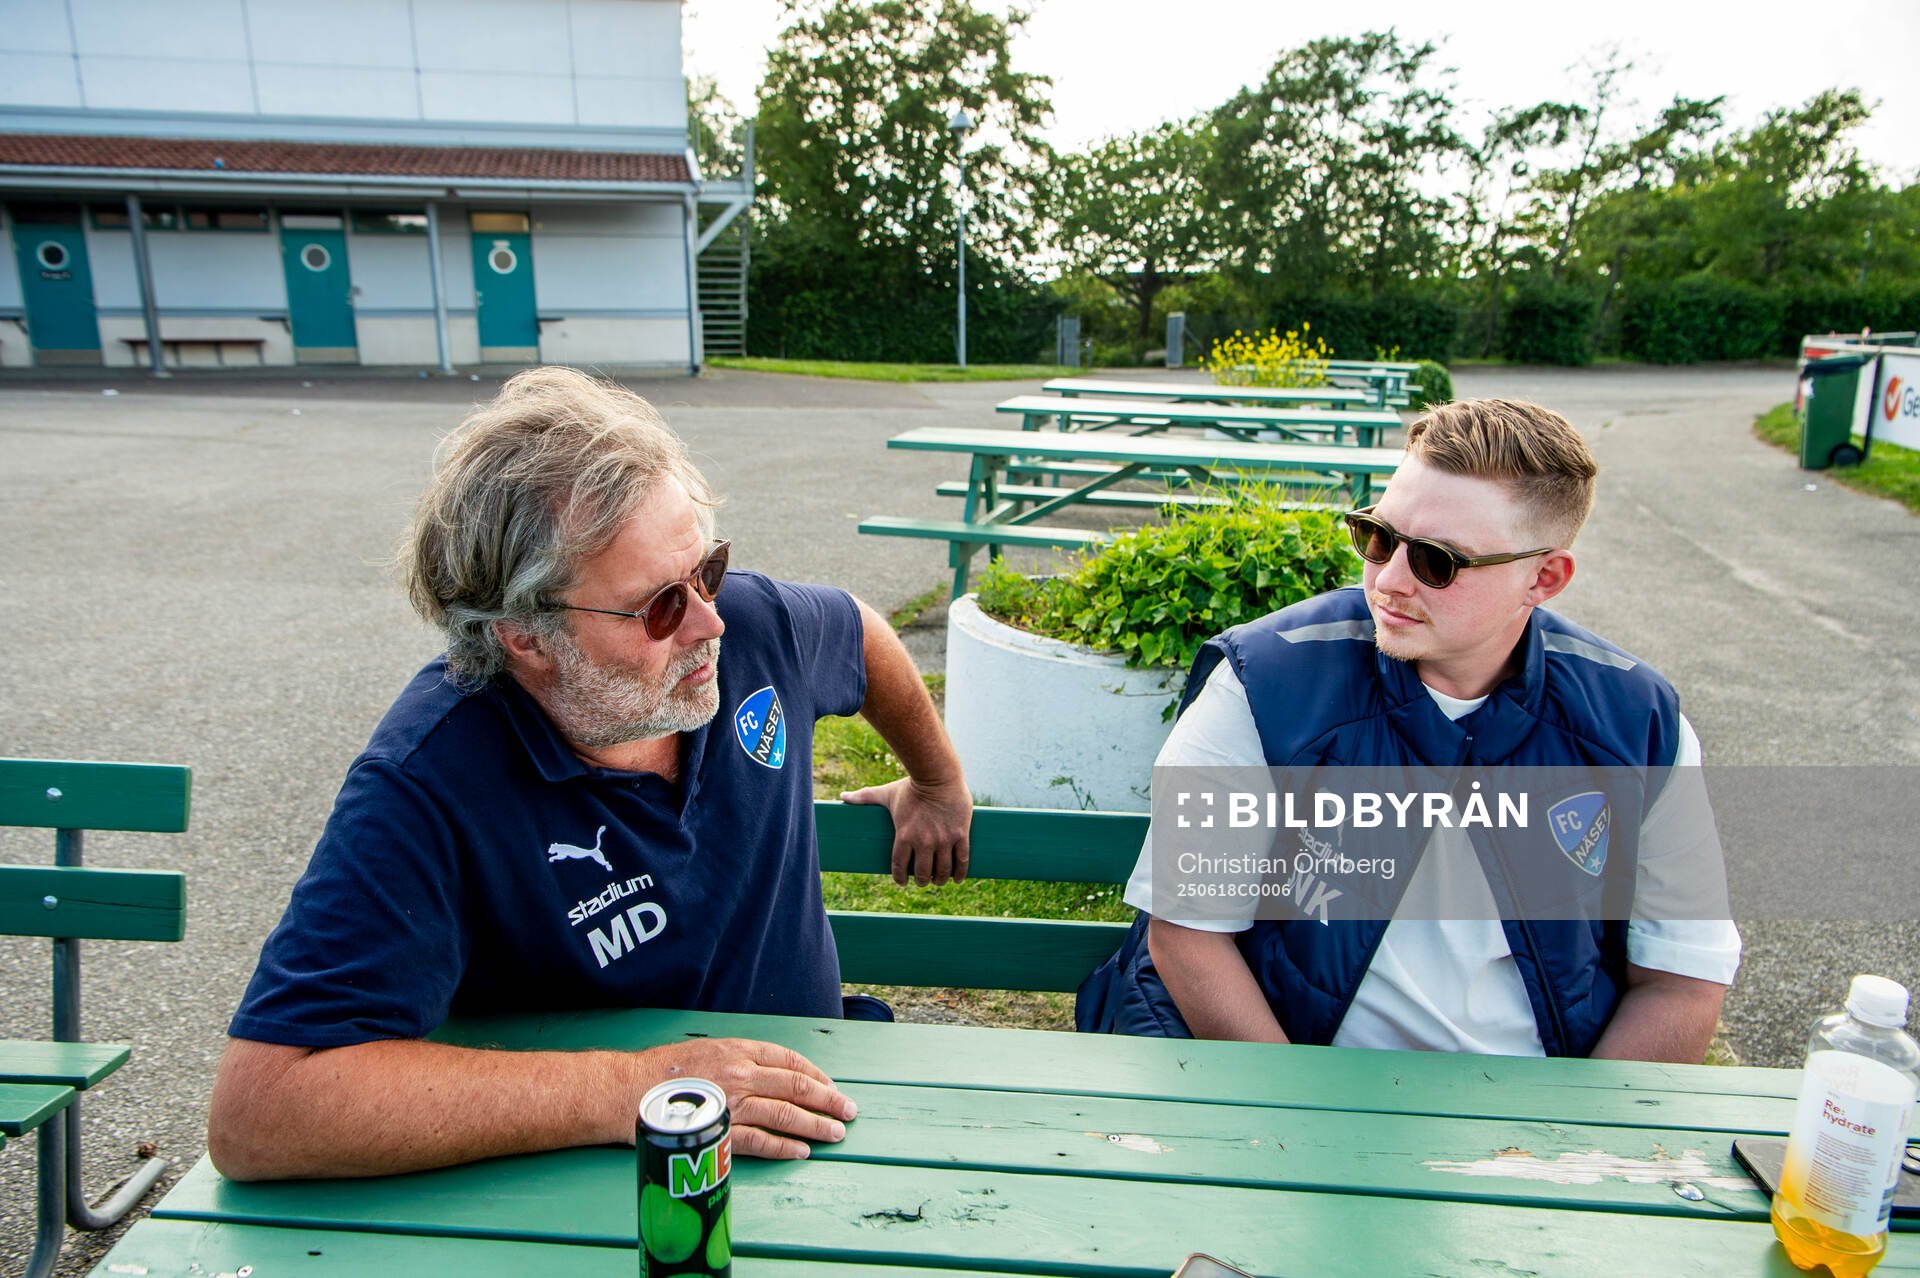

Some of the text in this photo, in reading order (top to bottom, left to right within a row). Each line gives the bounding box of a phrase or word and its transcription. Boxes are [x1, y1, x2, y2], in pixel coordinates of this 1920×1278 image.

[739, 710, 759, 737] FC
[757, 701, 780, 762] NÄSET
[1555, 810, 1583, 834] FC
[1575, 808, 1608, 865] NÄSET
[567, 873, 654, 927] stadium
[1287, 861, 1344, 927] NK
[586, 901, 667, 969] MD
[1822, 1107, 1877, 1136] hydrate
[1824, 1099, 1846, 1115] Re:
